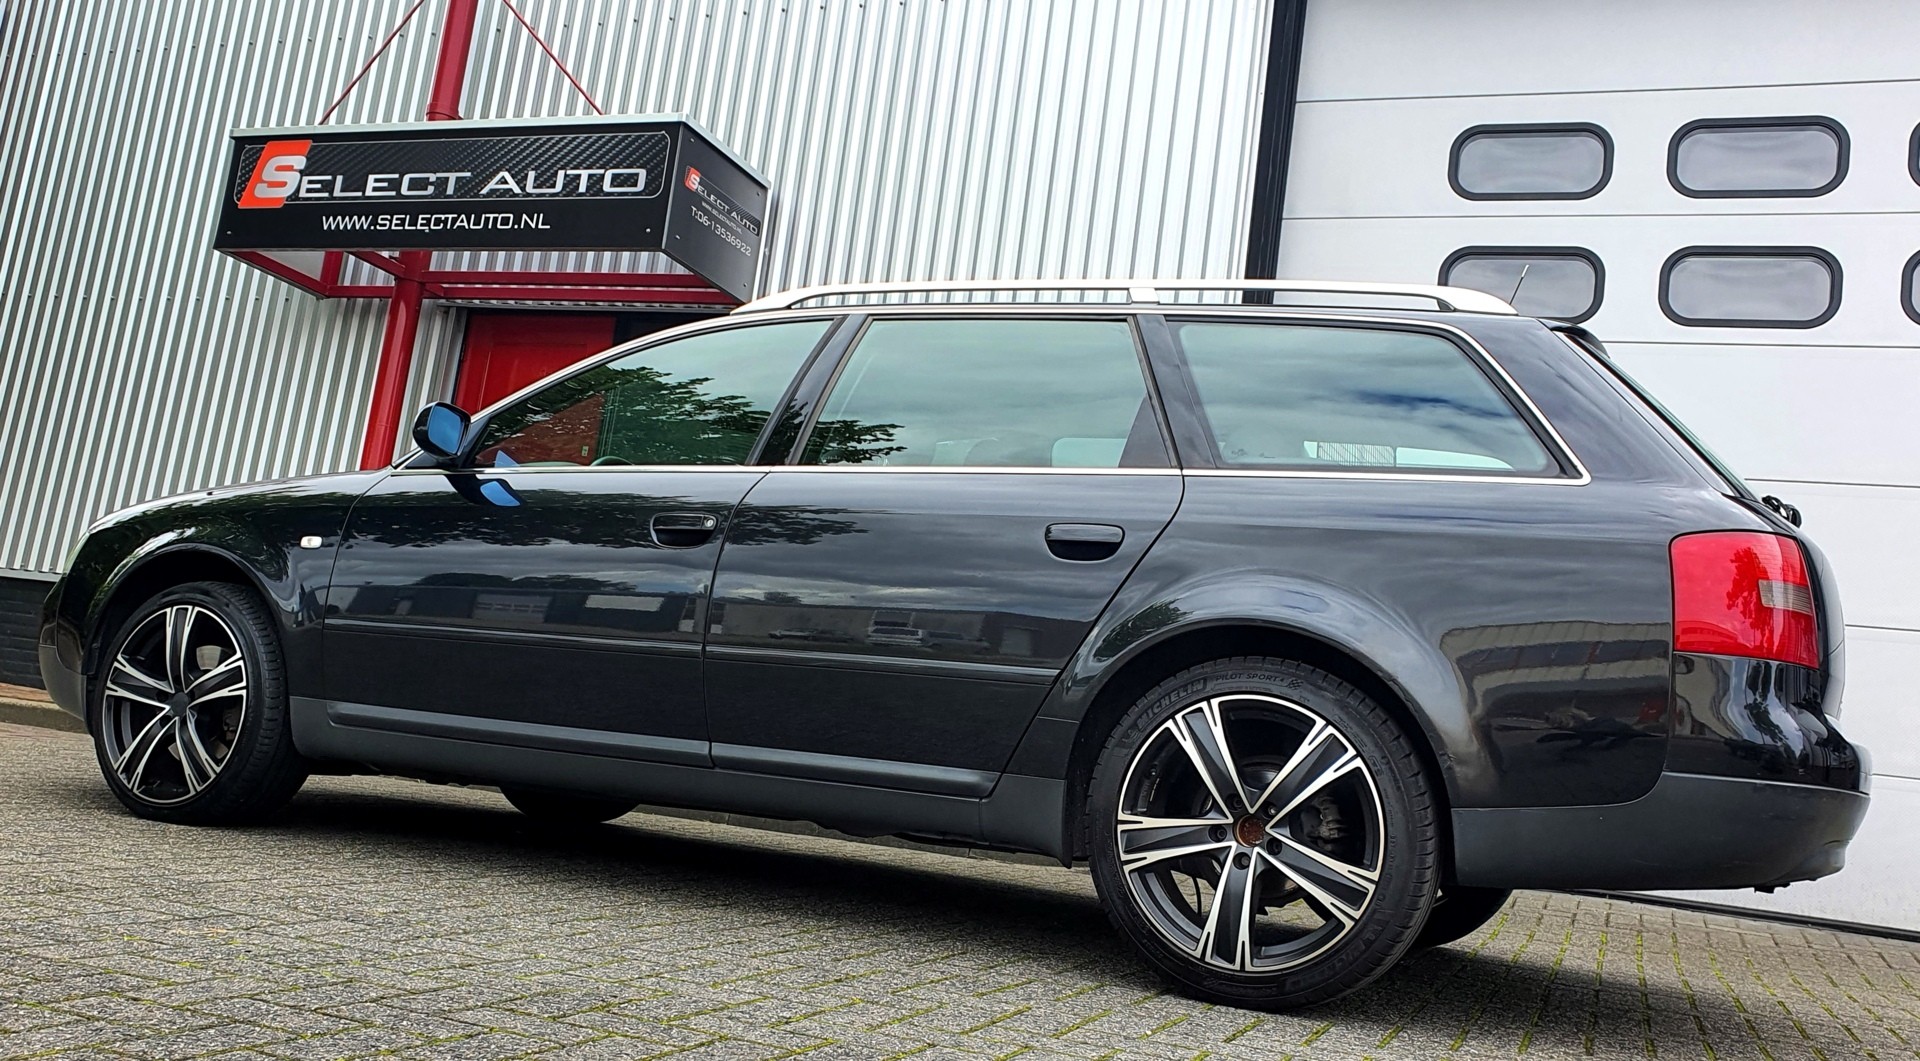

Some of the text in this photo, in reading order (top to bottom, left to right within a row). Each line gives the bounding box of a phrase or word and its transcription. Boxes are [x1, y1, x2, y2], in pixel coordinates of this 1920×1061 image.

[254, 154, 646, 199] SELECT AUTO
[321, 213, 551, 231] WWW.SELECTAUTO.NL
[688, 173, 758, 234] SELECT AUTO
[690, 205, 752, 256] T:06-13536922
[1215, 673, 1243, 682] PILOT
[1246, 672, 1279, 682] SPORT
[1136, 679, 1203, 730] MICHELIN
